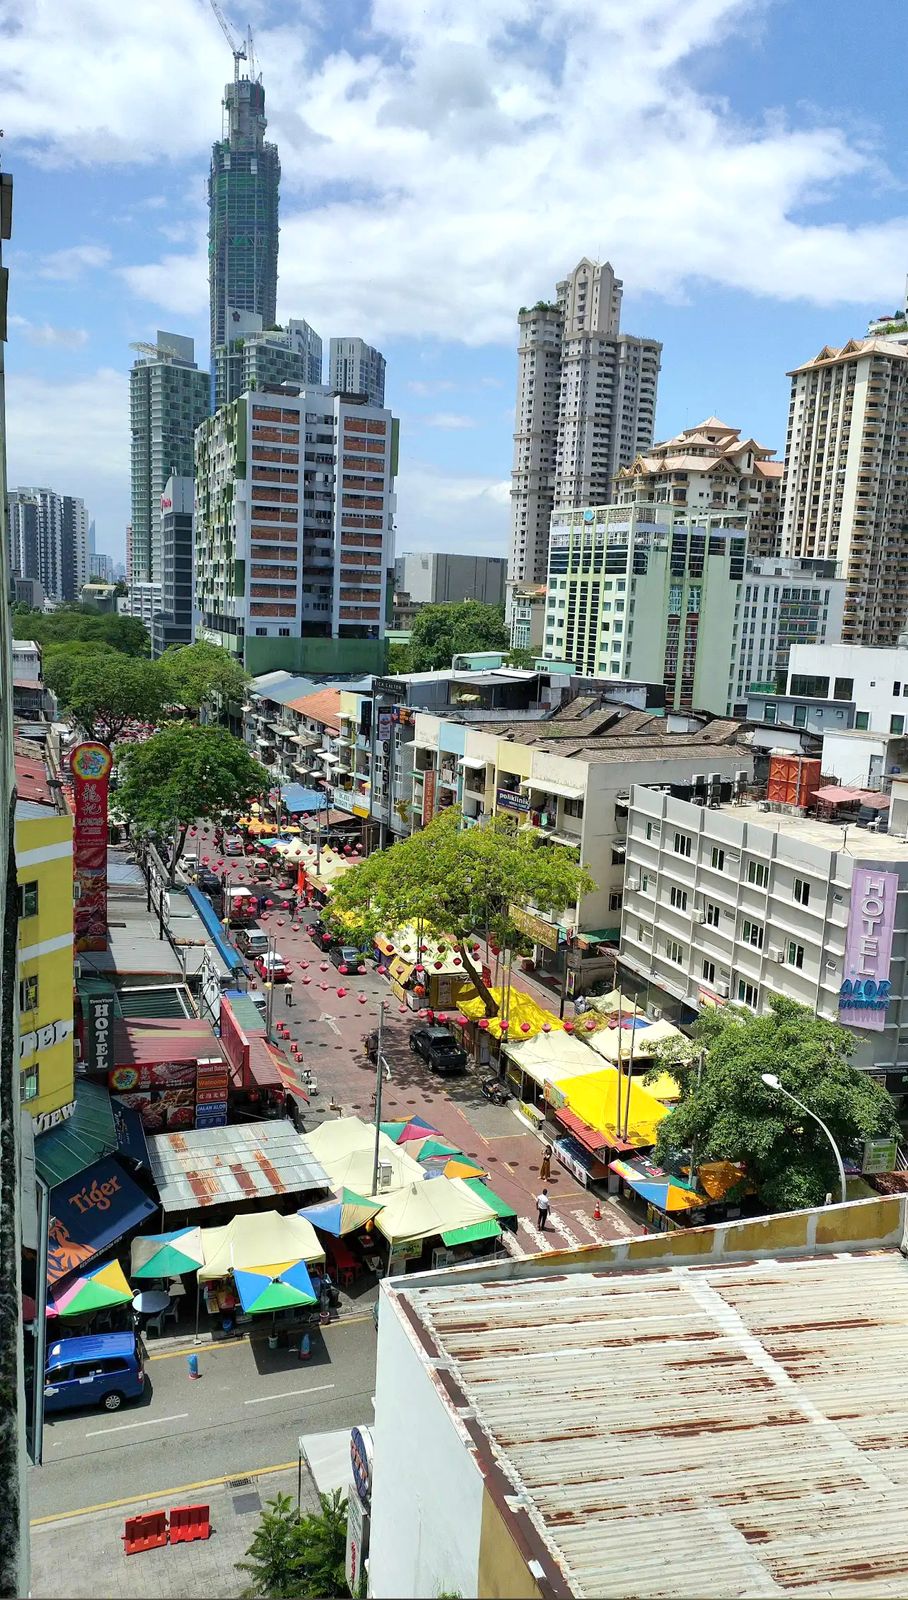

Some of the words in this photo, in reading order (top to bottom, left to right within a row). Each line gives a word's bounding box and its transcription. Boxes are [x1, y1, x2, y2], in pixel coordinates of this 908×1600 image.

[858, 876, 885, 976] HOTEL
[839, 977, 893, 999] ALOR
[94, 1004, 109, 1068] HOTEL
[32, 1100, 77, 1136] VIEW
[68, 1175, 122, 1214] Tiger
